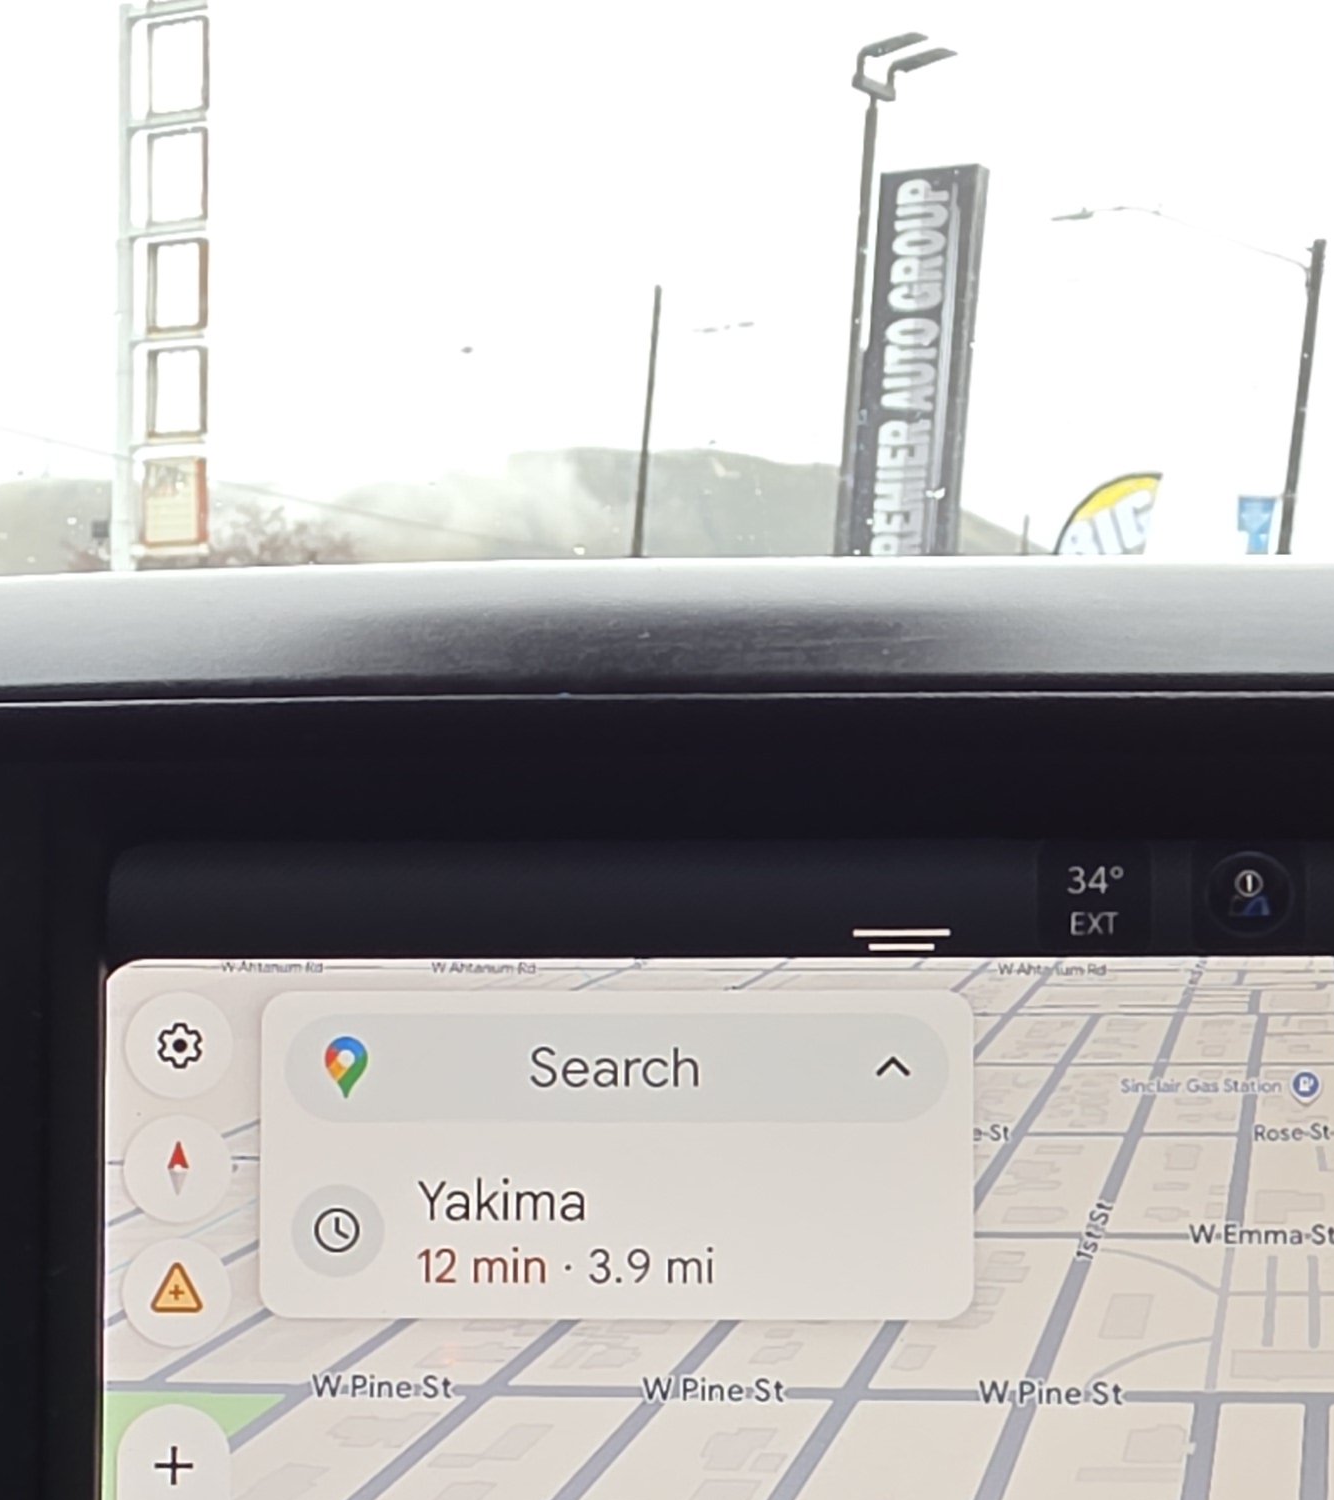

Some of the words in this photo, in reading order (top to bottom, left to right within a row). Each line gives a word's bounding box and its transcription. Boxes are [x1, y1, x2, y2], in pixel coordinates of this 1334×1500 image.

[887, 178, 949, 312] GROUP
[880, 318, 939, 412] AUTO
[1070, 912, 1118, 936] EXT
[518, 962, 536, 974] Rd
[998, 963, 1015, 975] W
[1087, 963, 1107, 976] Rd
[529, 1046, 700, 1089] Search
[1121, 1079, 1180, 1094] Sinclair
[1187, 1079, 1218, 1094] Gas
[1223, 1079, 1282, 1094] Station
[990, 1125, 1009, 1141] St
[1254, 1126, 1301, 1142] Rose
[1310, 1125, 1331, 1141] St
[418, 1178, 587, 1222] Yakima
[1089, 1203, 1114, 1226] St
[1077, 1231, 1102, 1260] 1st
[1190, 1224, 1216, 1244] W
[1224, 1223, 1303, 1245] Emma
[419, 1250, 455, 1284] 12
[473, 1248, 546, 1284] min
[588, 1250, 651, 1284] 3.9
[667, 1247, 714, 1284] mi
[312, 1374, 347, 1399] W
[351, 1374, 410, 1399] Pine
[421, 1374, 453, 1399] St
[644, 1378, 677, 1403] W
[682, 1378, 744, 1403] Pine
[754, 1378, 785, 1403] St
[979, 1381, 1013, 1405] W
[1019, 1381, 1082, 1406] Pine
[1092, 1381, 1123, 1406] St
